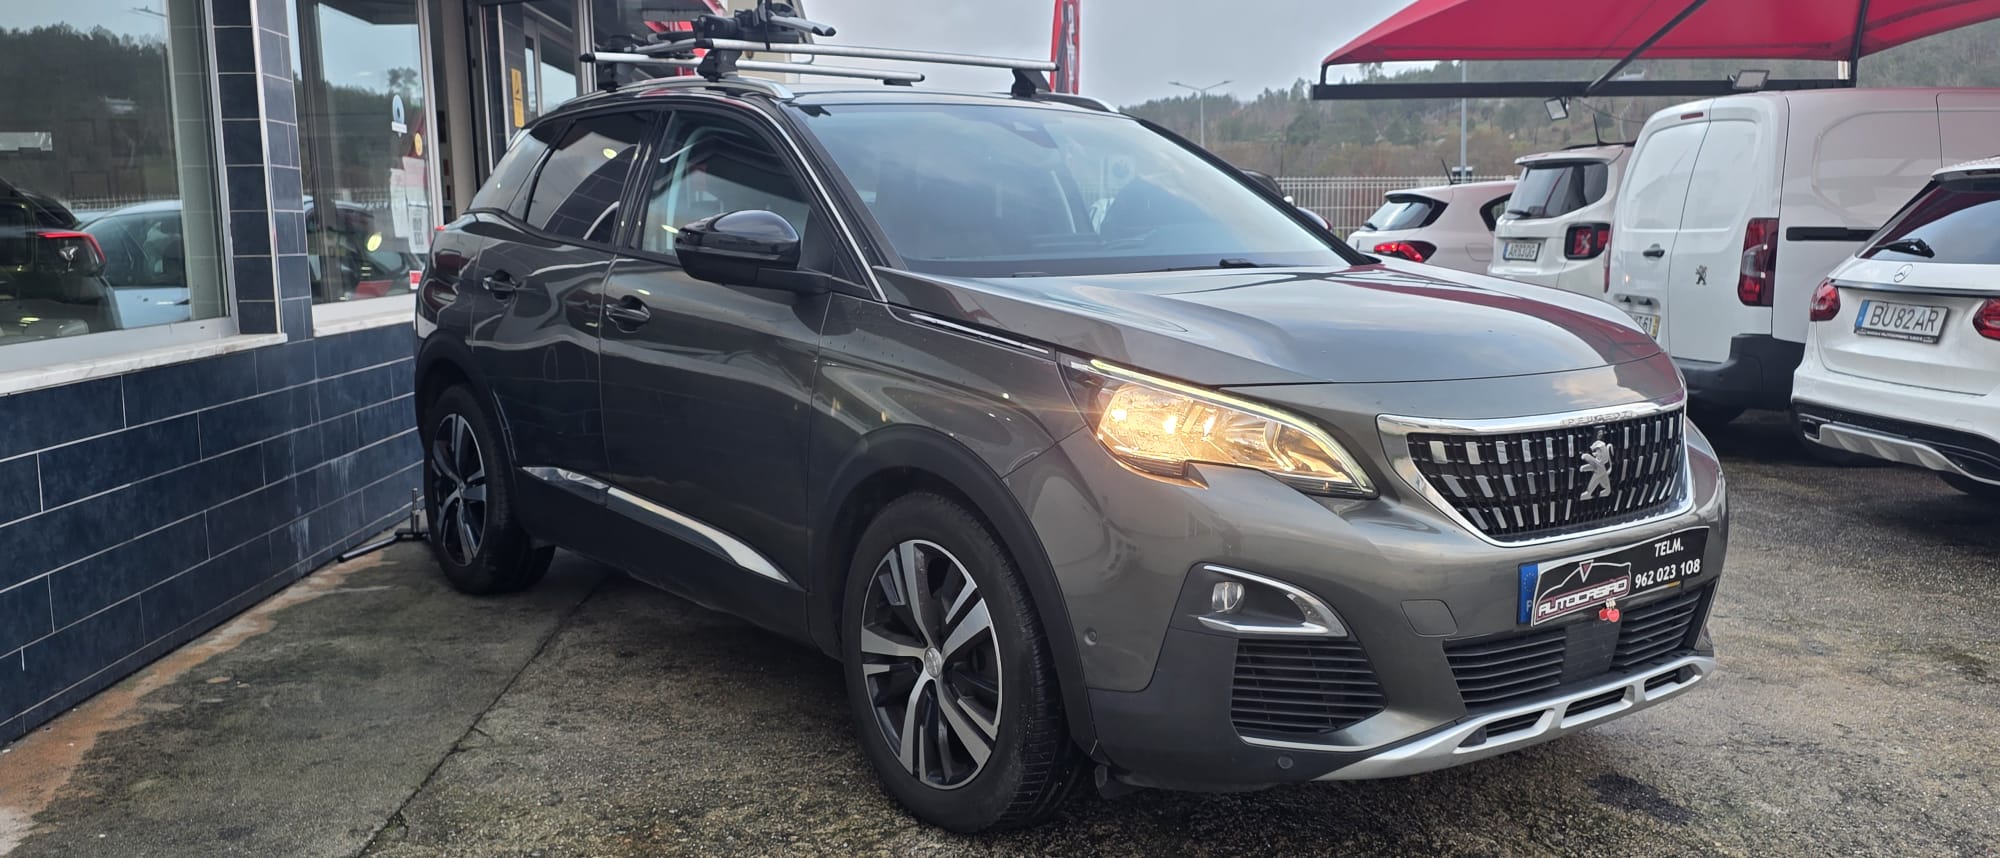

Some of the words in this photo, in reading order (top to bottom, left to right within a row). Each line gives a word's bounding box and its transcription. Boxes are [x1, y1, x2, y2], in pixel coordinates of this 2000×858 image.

[1654, 537, 1684, 557] TELM.
[1635, 570, 1654, 589] 962
[1656, 564, 1676, 582] 023
[1680, 558, 1700, 576] 108
[1526, 599, 1533, 613] P
